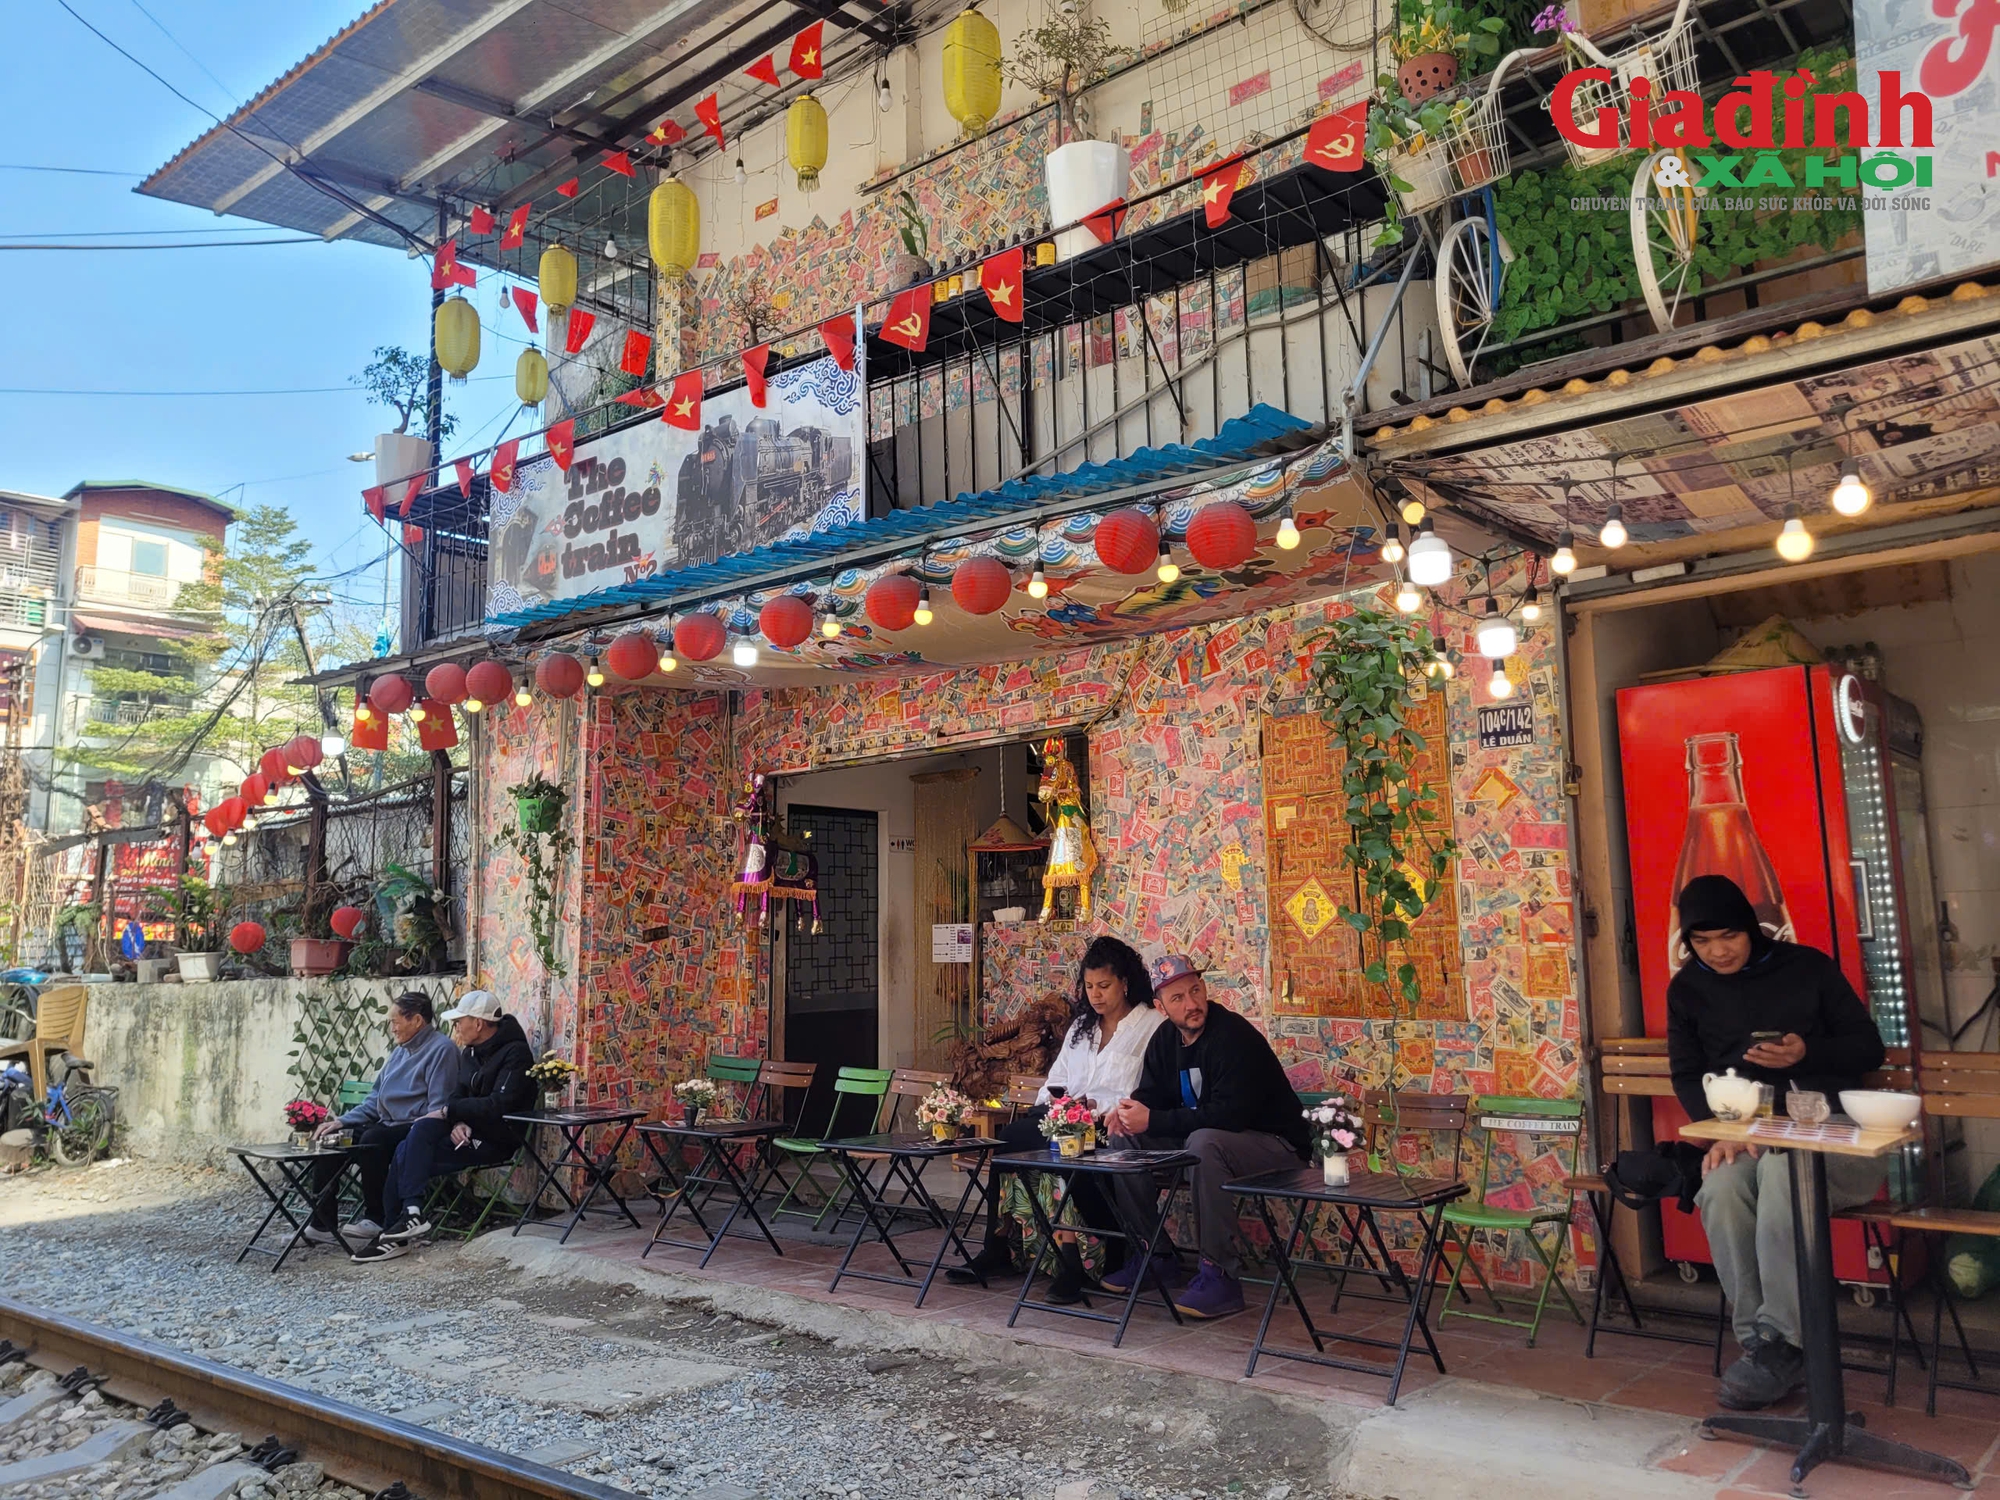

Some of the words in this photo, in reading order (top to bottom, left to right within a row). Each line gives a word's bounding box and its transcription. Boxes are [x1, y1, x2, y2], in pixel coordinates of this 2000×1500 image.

[564, 455, 627, 501] The
[563, 486, 662, 540] Coffee
[561, 528, 641, 580] train
[1480, 707, 1532, 734] 104C/142
[1483, 735, 1496, 748] LÊ
[1549, 1121, 1578, 1130] TRAIN
